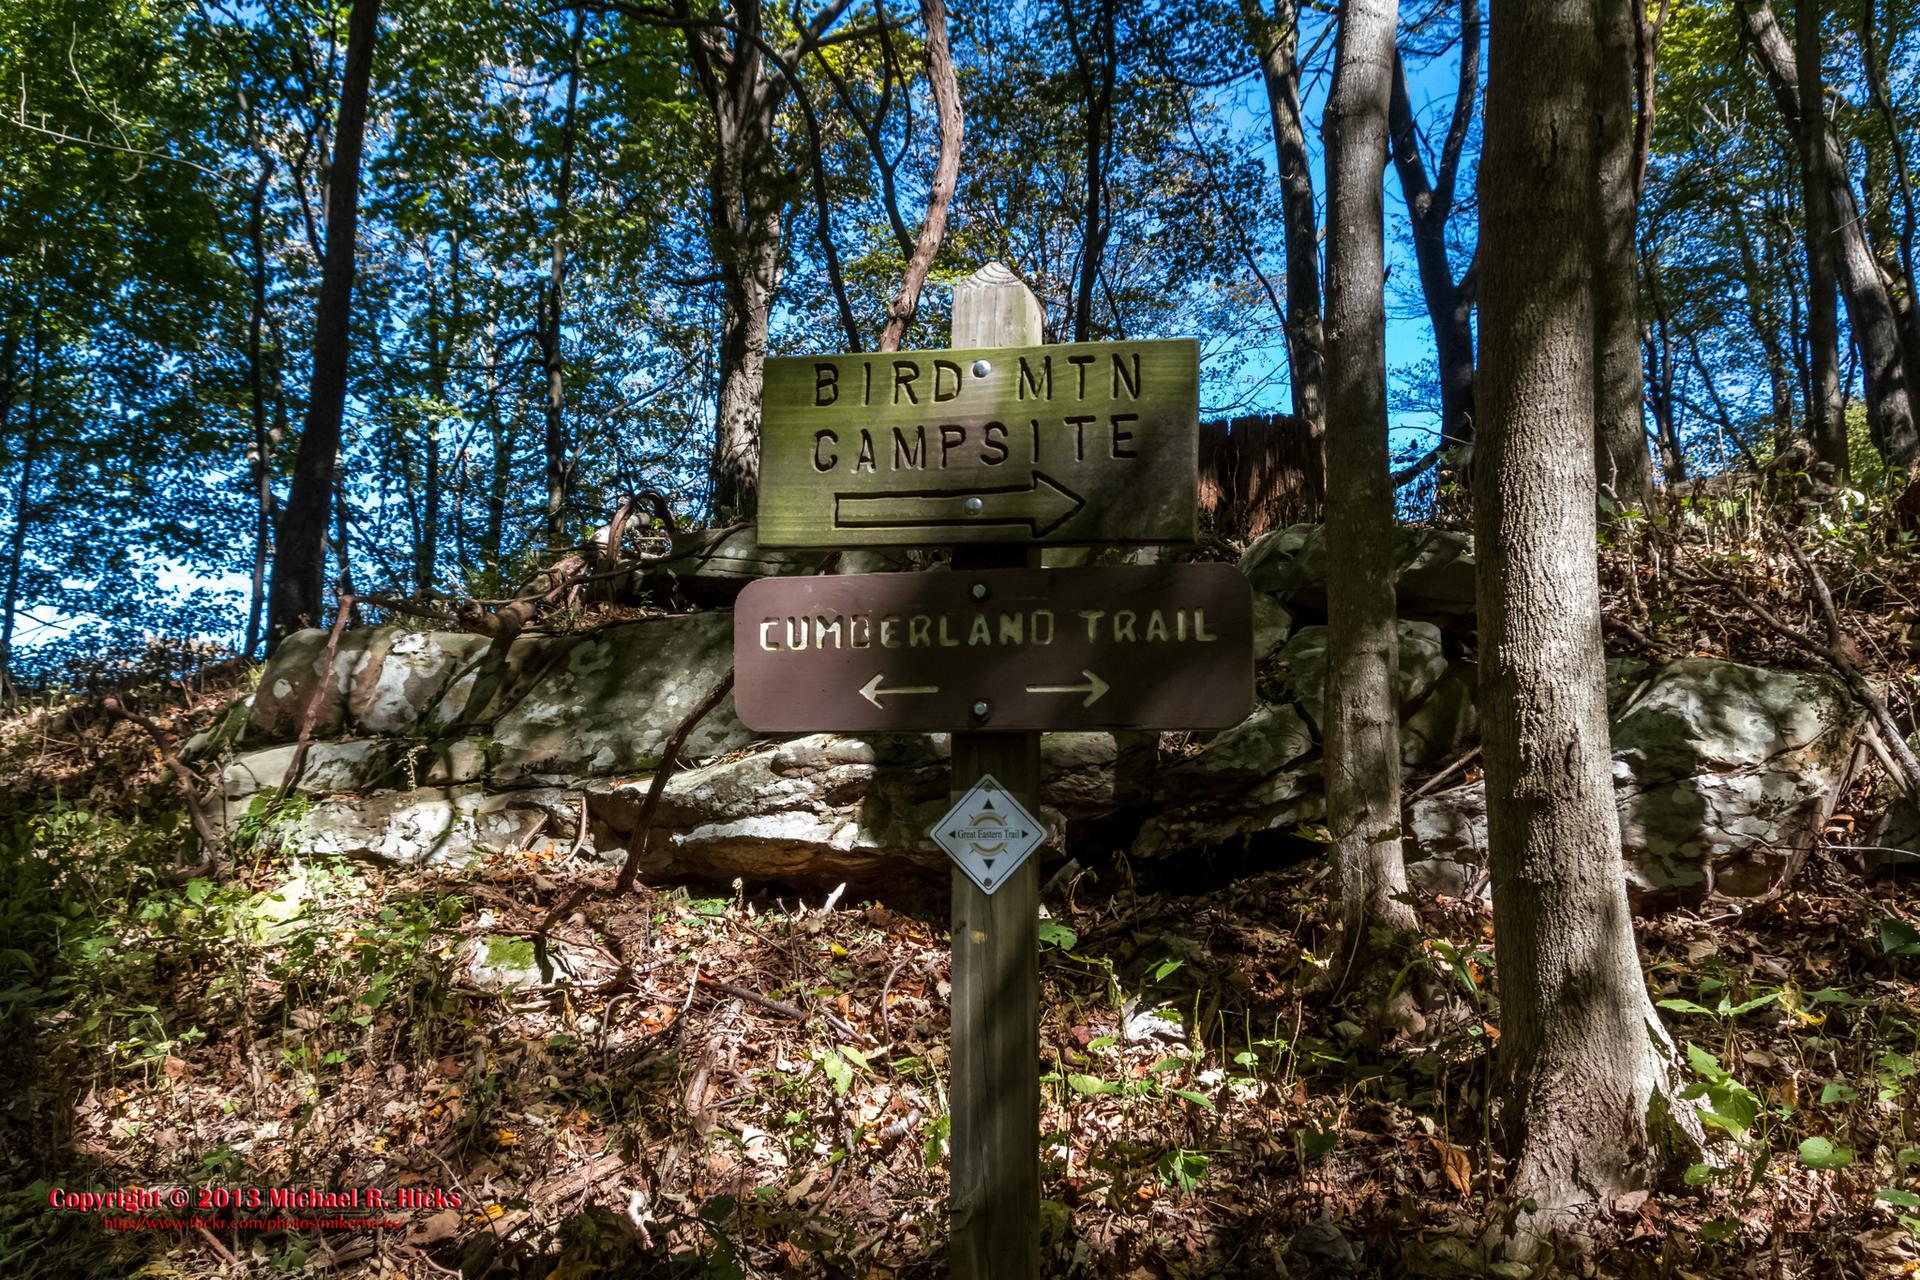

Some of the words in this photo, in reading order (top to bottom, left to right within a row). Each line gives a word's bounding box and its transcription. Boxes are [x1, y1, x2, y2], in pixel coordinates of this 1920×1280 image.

[814, 359, 963, 407] BIRD
[1016, 352, 1141, 401] MTN
[812, 413, 1140, 473] CAMPSITE
[759, 608, 1055, 652] CUMBERLAND
[1079, 606, 1218, 644] TRAIL
[957, 829, 976, 839] Great
[978, 829, 1002, 839] Eastern
[1004, 829, 1020, 839] Trail
